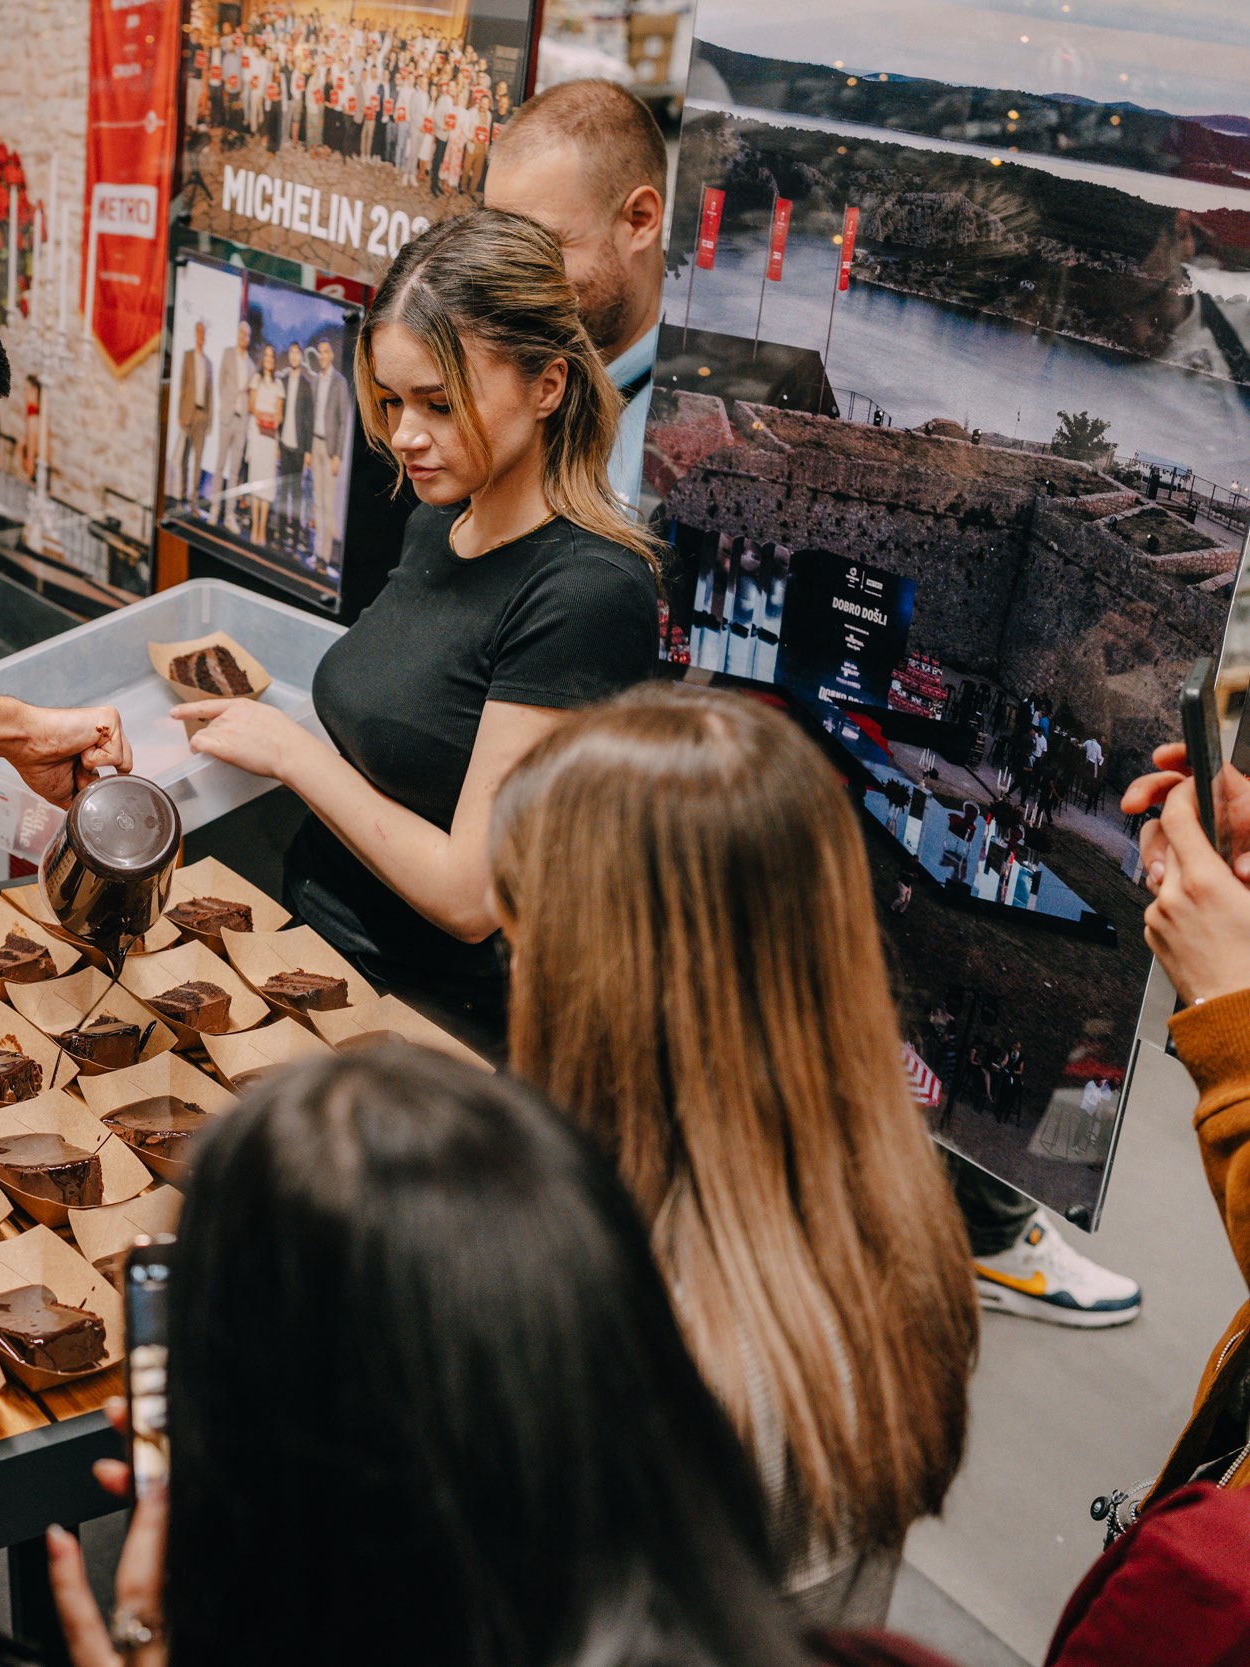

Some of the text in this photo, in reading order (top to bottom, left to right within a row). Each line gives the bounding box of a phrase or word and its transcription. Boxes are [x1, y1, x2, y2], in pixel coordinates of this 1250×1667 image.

[222, 165, 363, 249] MICHELIN
[832, 596, 888, 626] DOBRO DOŠLI
